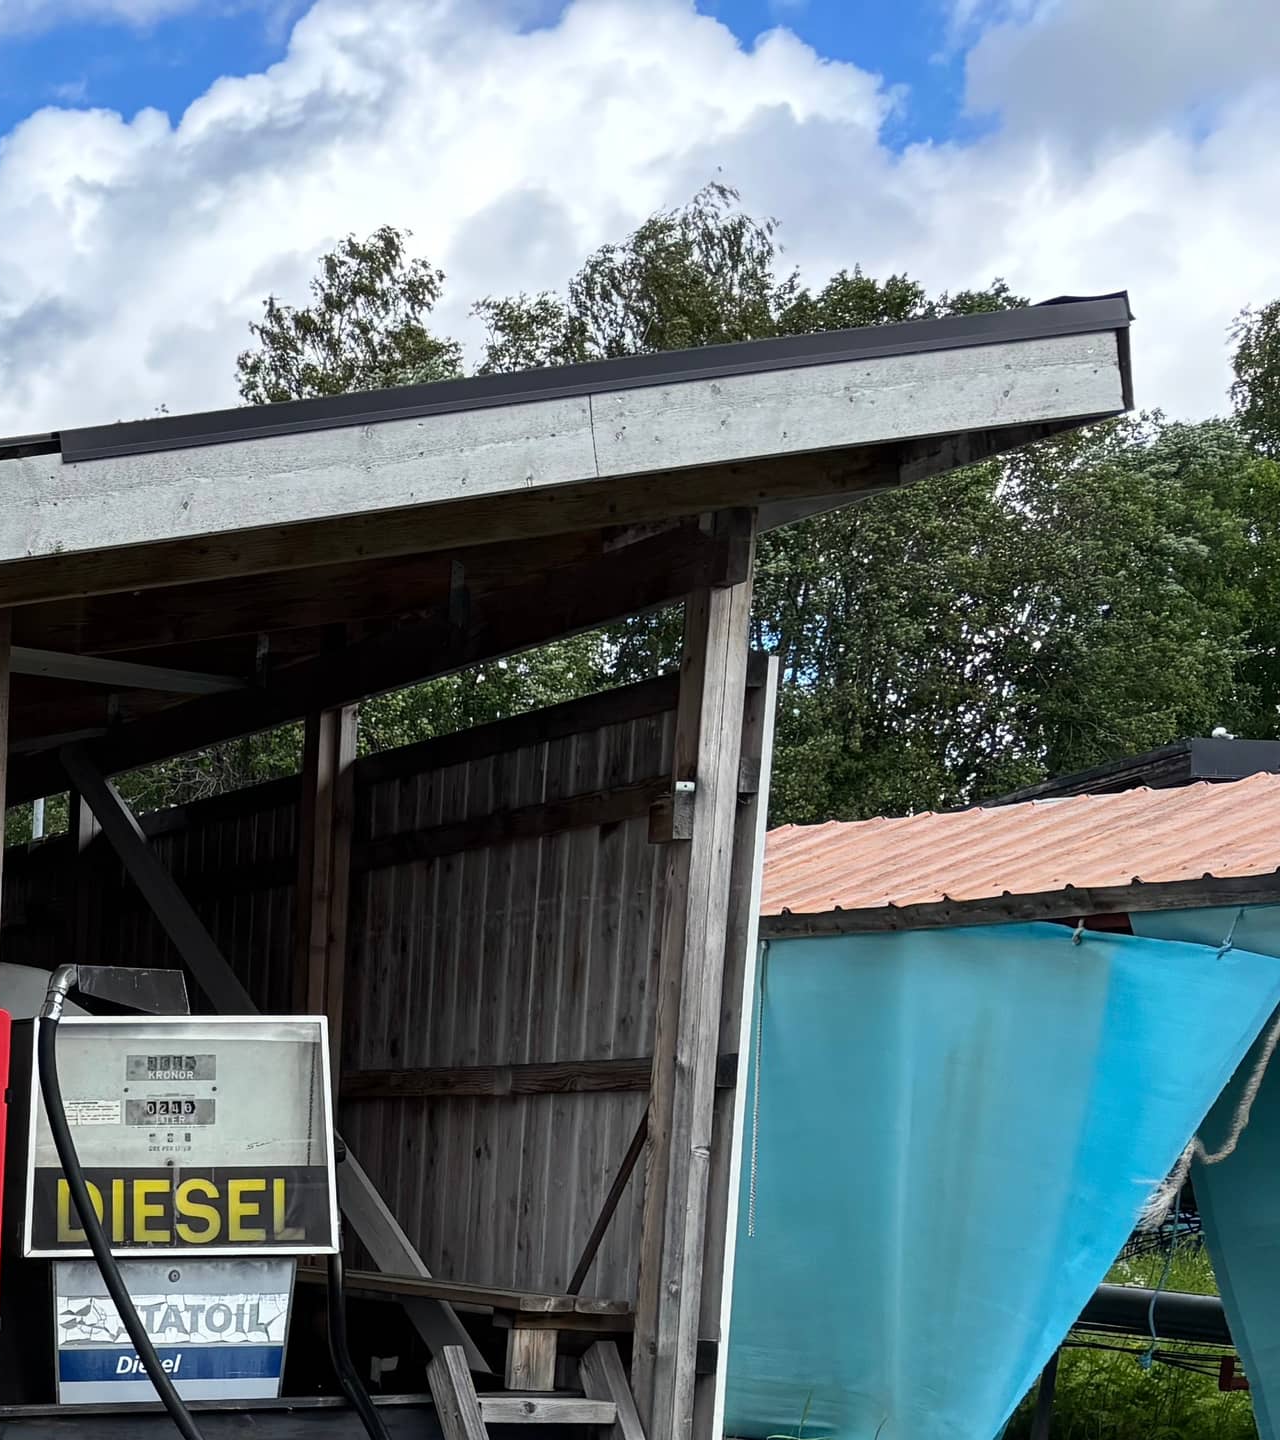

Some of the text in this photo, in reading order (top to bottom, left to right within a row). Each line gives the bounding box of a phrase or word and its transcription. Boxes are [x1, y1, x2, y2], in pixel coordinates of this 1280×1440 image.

[148, 1071, 194, 1080] KRONOR
[57, 1178, 306, 1244] DIESEL
[116, 1303, 267, 1334] TATOIL
